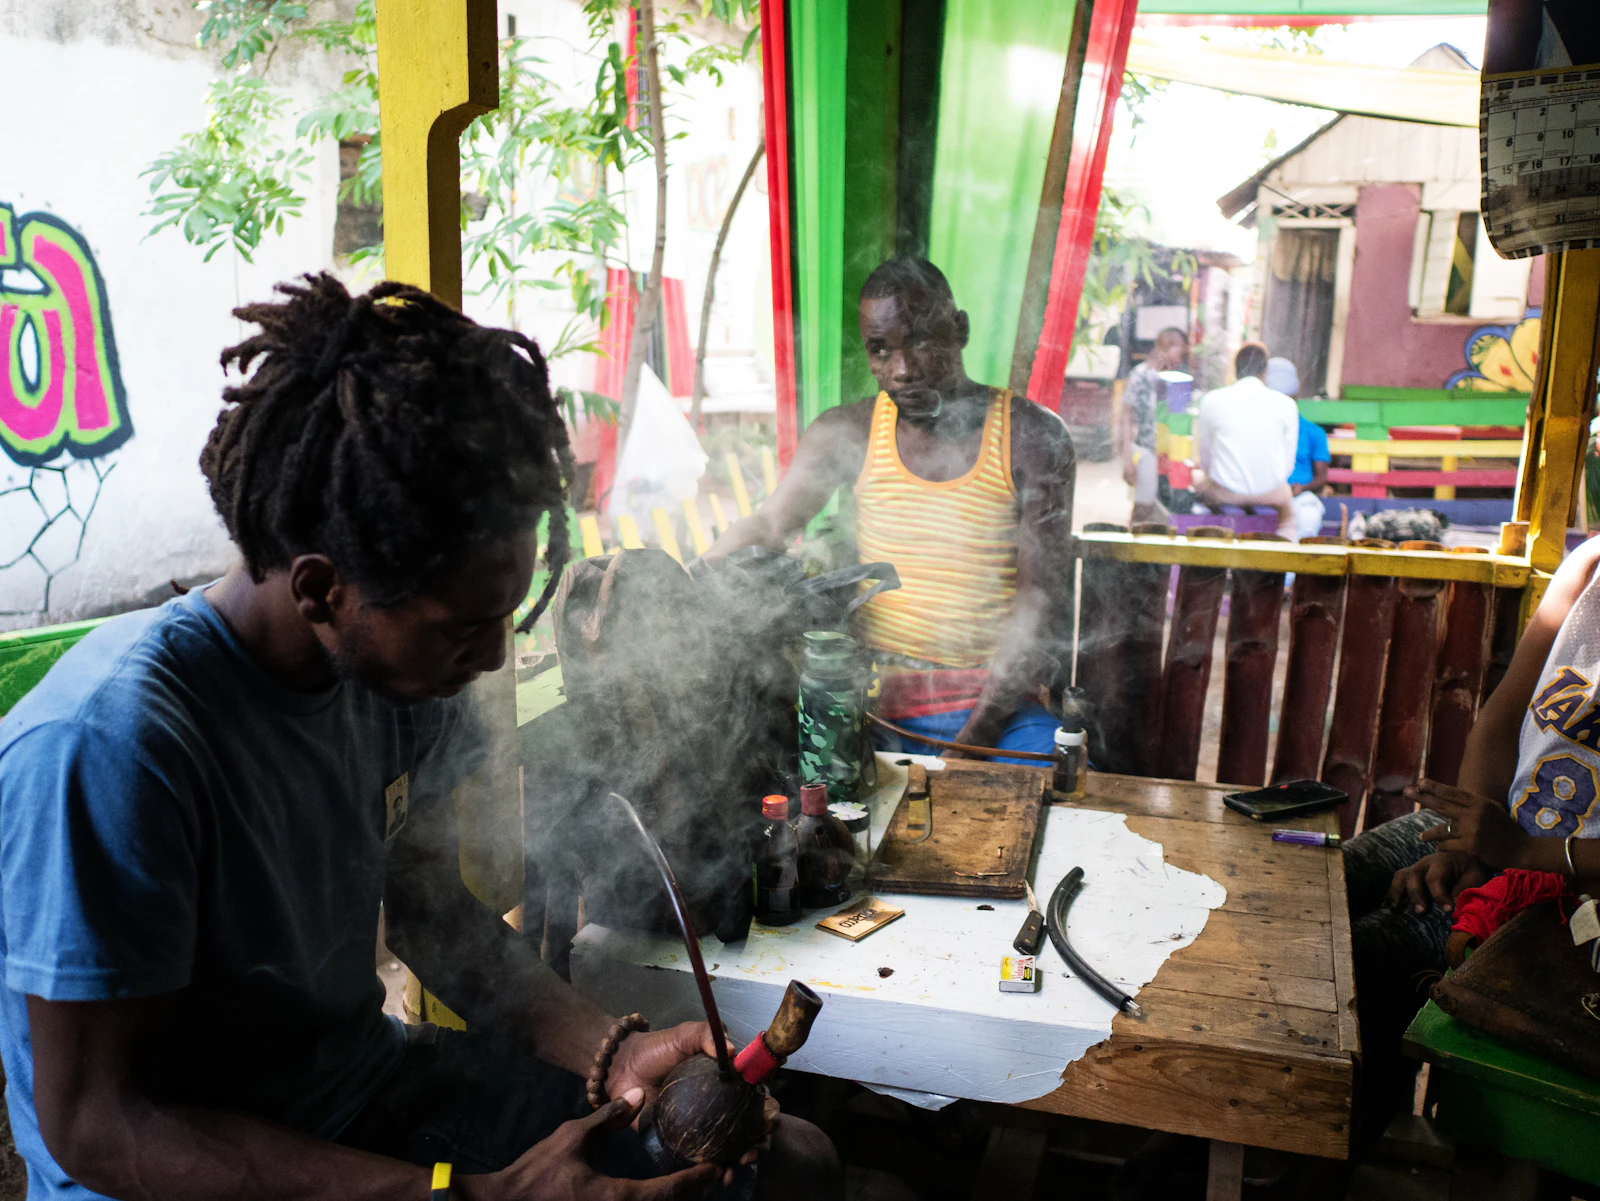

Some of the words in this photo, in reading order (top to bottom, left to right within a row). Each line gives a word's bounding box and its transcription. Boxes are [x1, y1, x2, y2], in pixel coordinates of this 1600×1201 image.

[1540, 107, 1547, 116] 2
[1570, 103, 1576, 112] 3
[1506, 137, 1513, 147] 8
[1537, 132, 1544, 142] 9
[1562, 129, 1574, 139] 10
[1502, 166, 1512, 175] 15
[1531, 160, 1543, 170] 16
[1560, 156, 1571, 167] 17
[1528, 188, 1539, 198] 23
[1554, 184, 1567, 195] 24
[1586, 182, 1599, 192] 25
[1555, 213, 1566, 224] 31
[1511, 753, 1600, 839] 8
